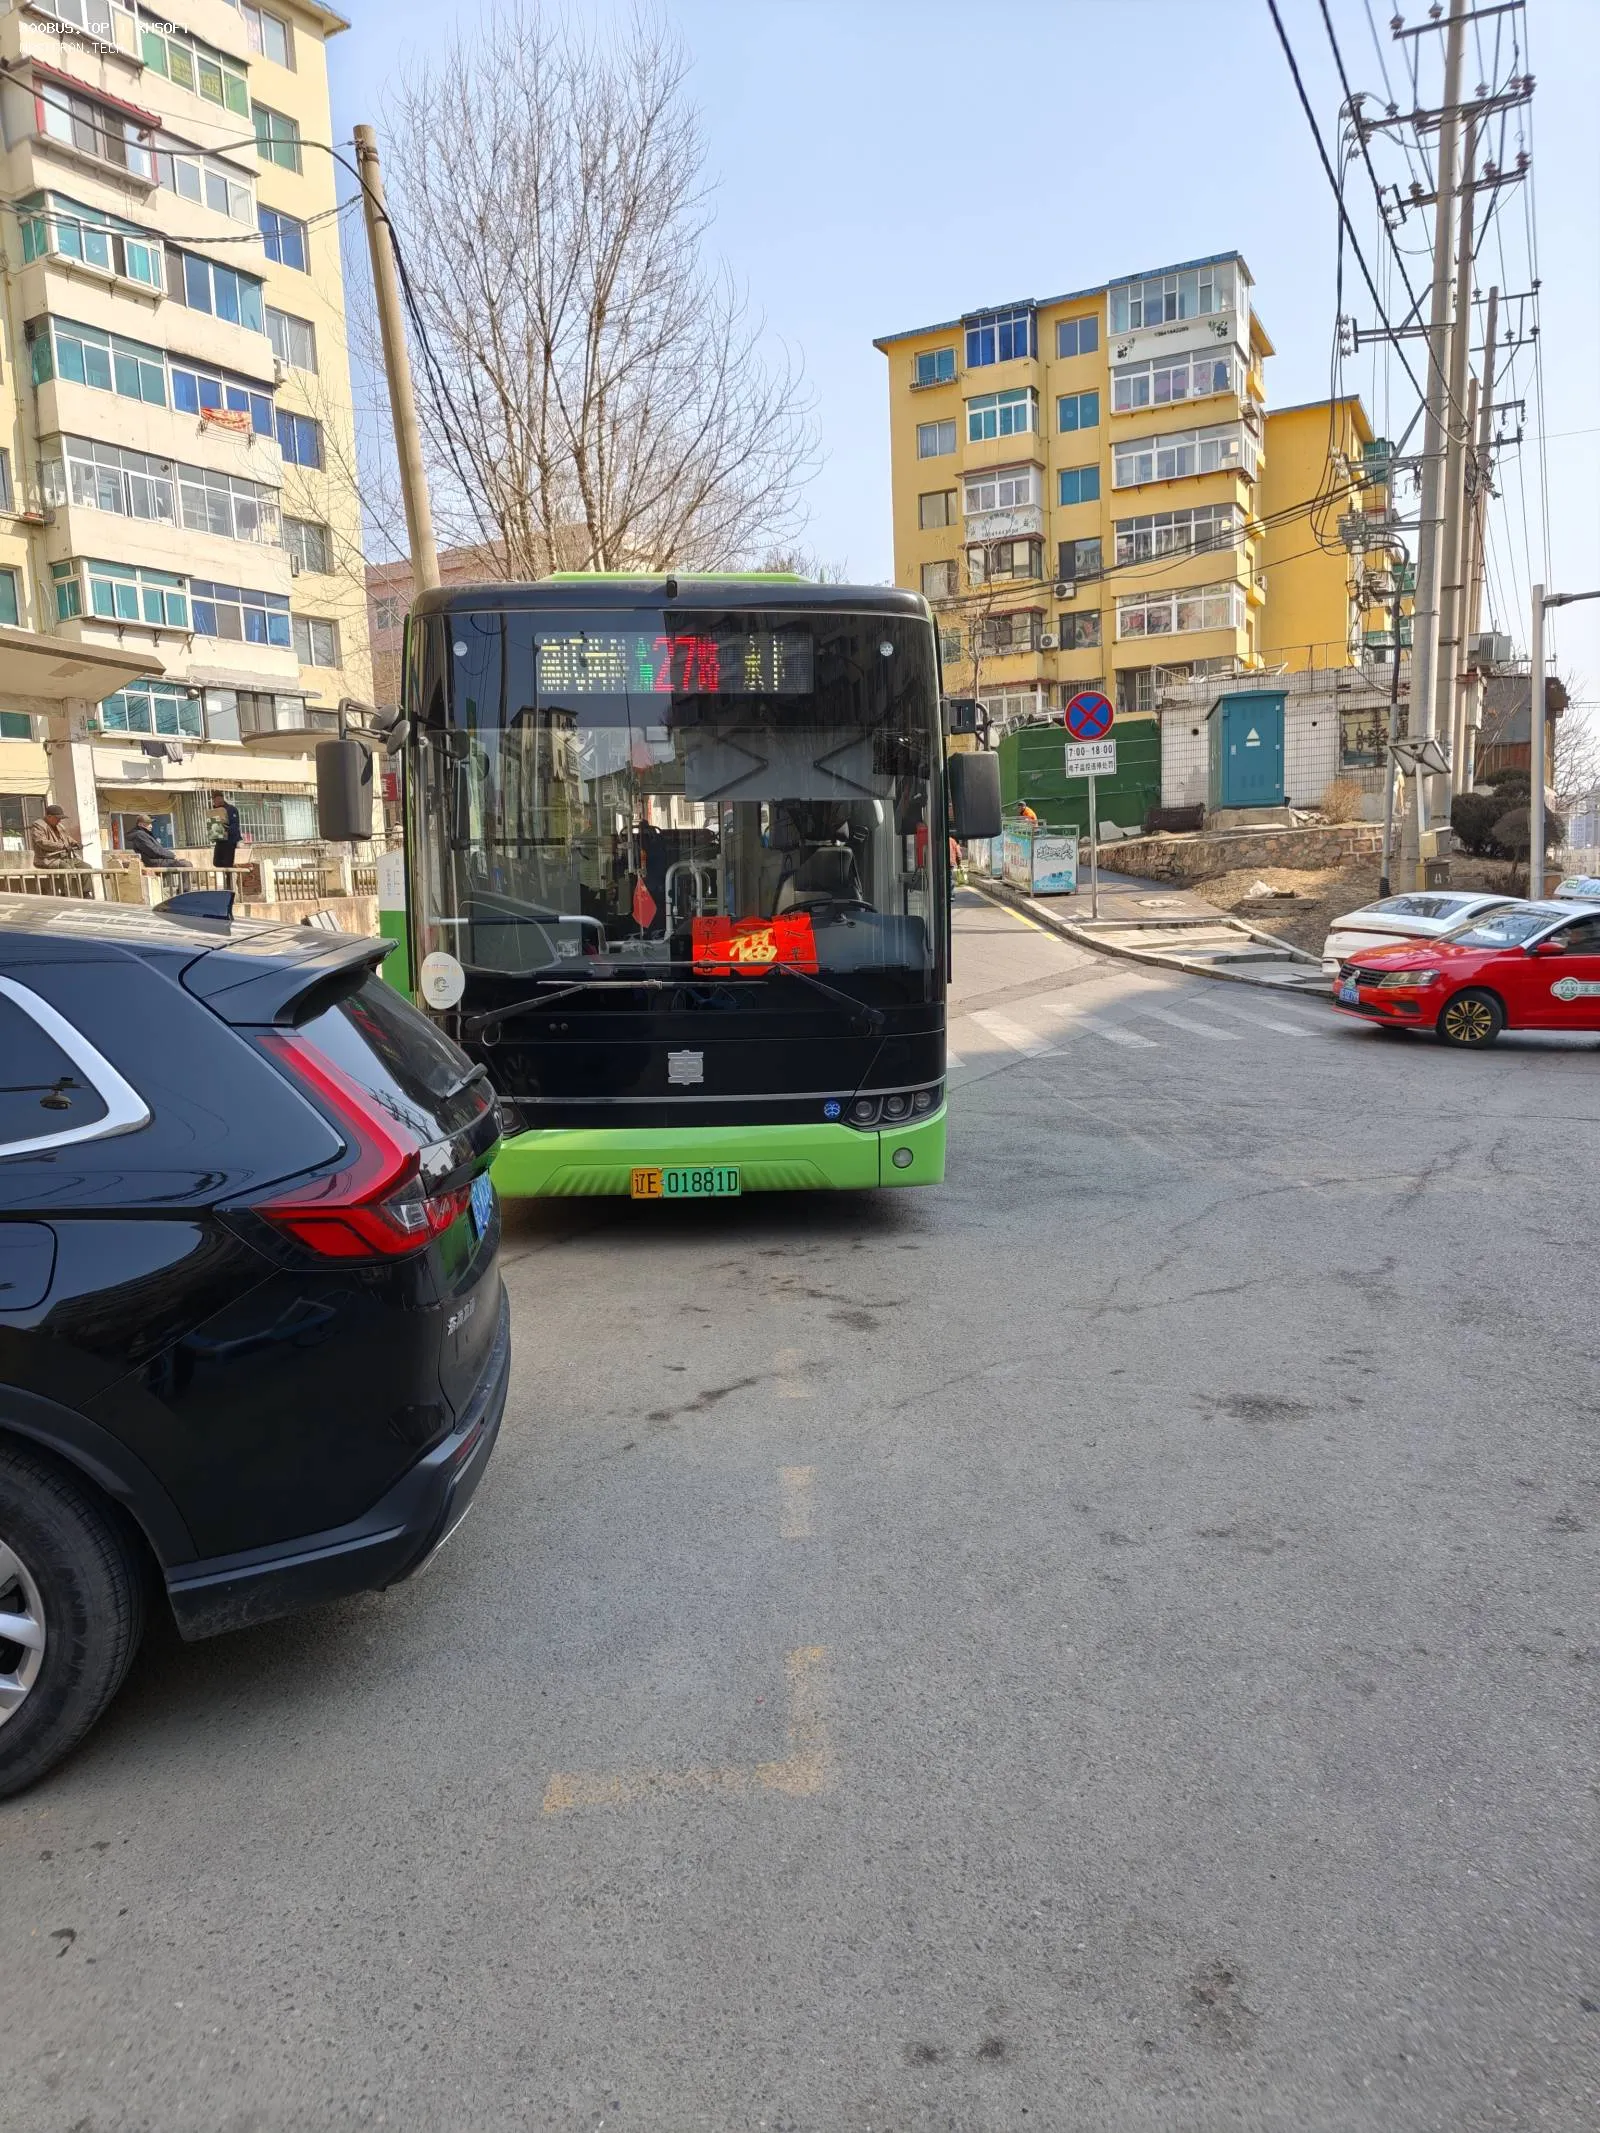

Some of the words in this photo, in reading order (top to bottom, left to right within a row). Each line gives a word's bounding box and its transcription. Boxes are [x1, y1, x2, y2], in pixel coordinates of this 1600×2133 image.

[729, 927, 778, 963] 福
[634, 1173, 658, 1194] 辽E
[667, 1170, 738, 1193] 01881D
